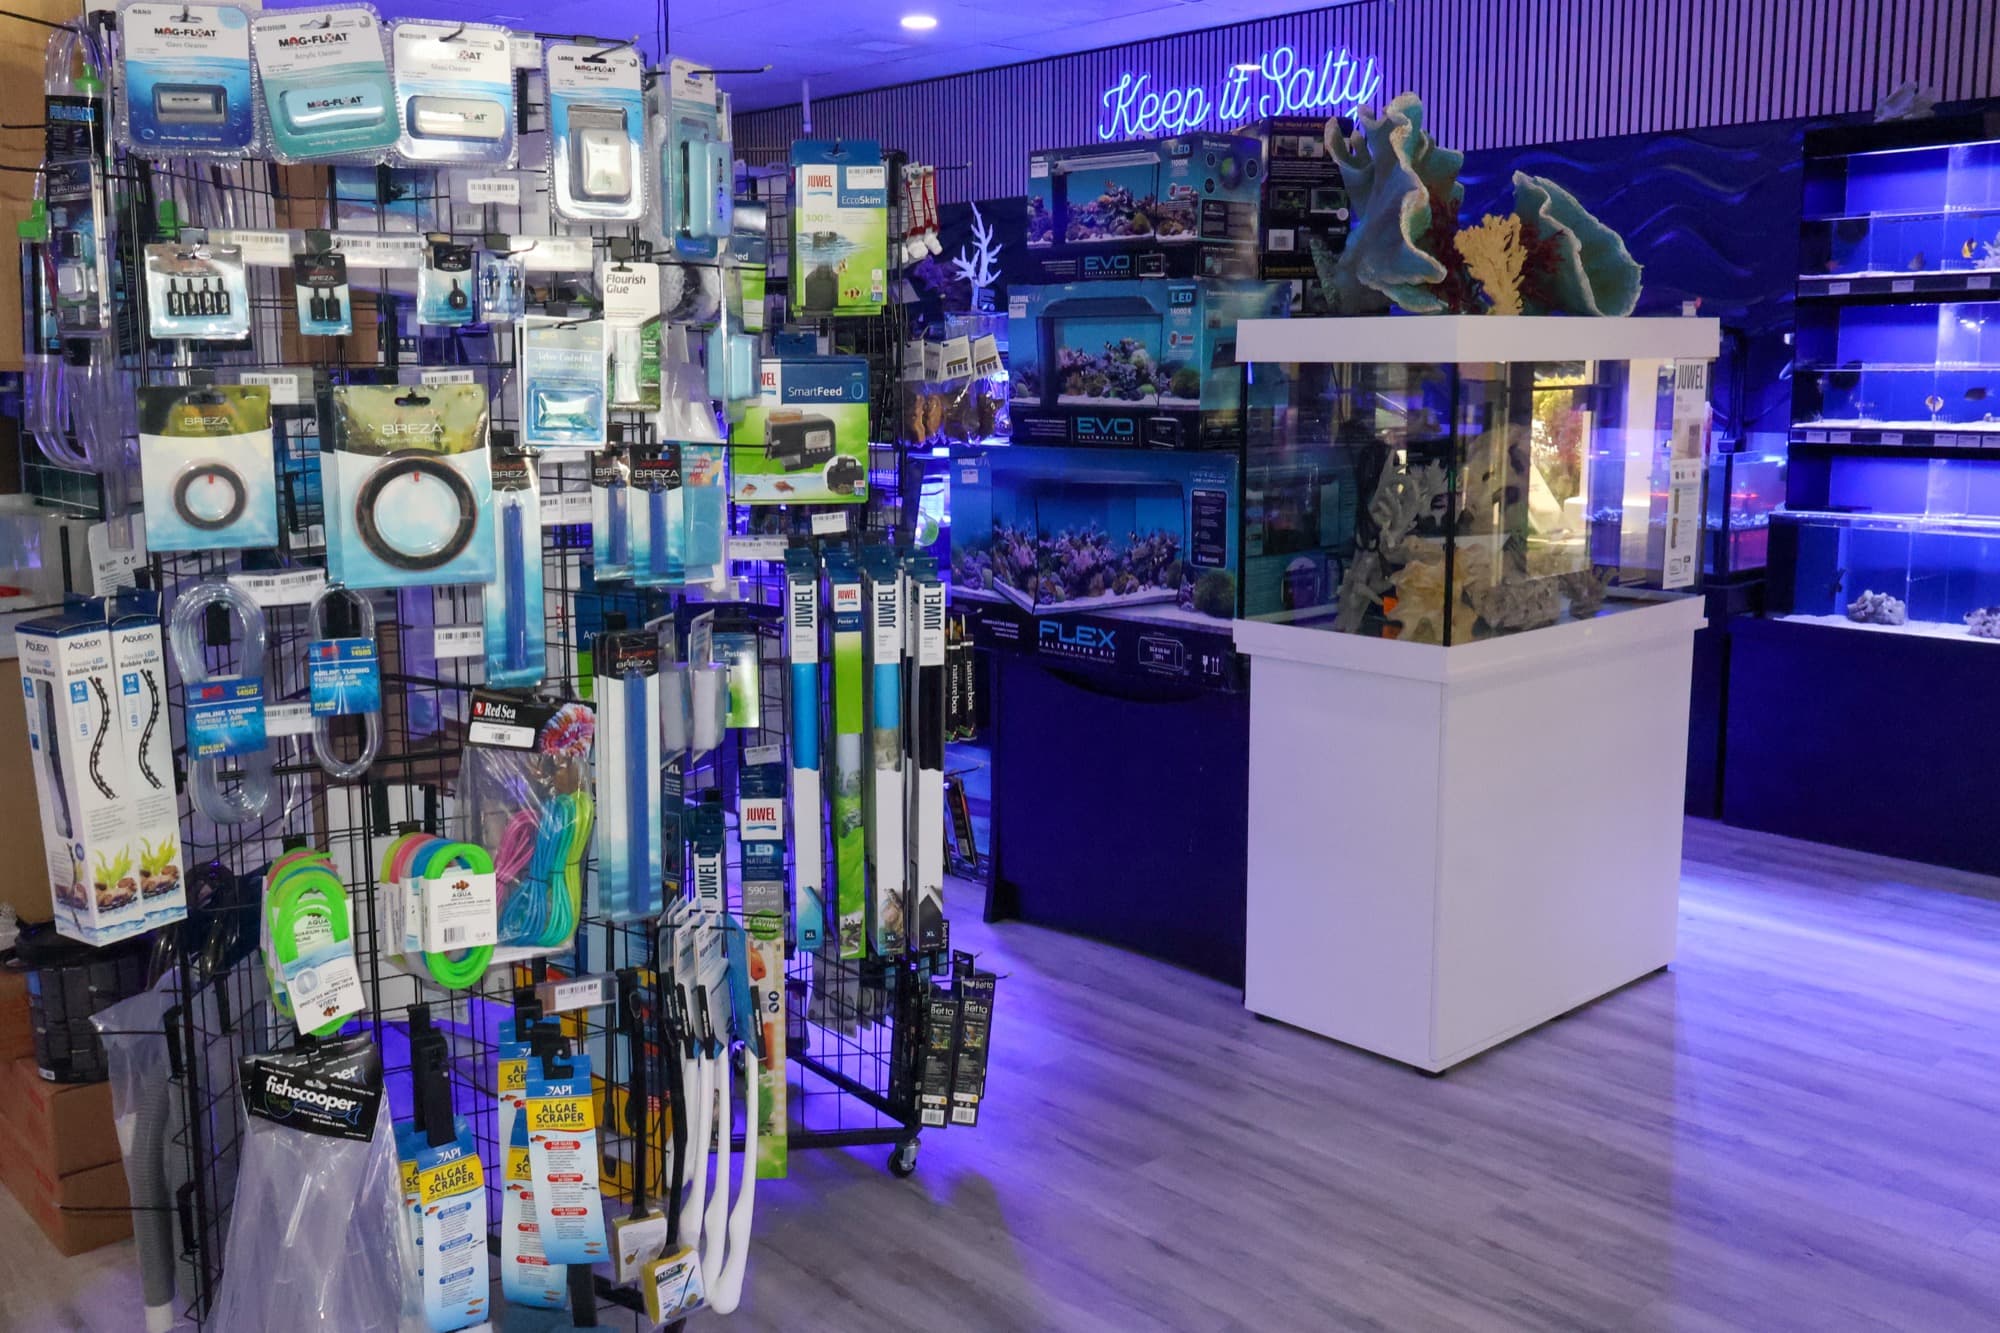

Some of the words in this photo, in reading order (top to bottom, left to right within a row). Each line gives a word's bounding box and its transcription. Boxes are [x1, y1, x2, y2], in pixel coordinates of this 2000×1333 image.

[154, 27, 216, 38] MAG-FLOAT
[278, 33, 348, 47] MAG-FLOAT
[1099, 74, 1211, 140] Keep
[1220, 67, 1250, 119] it
[1260, 47, 1380, 130] Salty
[808, 175, 833, 188] JUWEL
[841, 196, 881, 205] EccoSkim
[1084, 255, 1130, 270] EVO
[606, 273, 647, 286] Flourish
[606, 284, 629, 294] Glue
[1171, 292, 1192, 303] LED
[1677, 365, 1704, 391] JUWEL
[788, 386, 842, 397] SmartFeed
[184, 416, 230, 426] BREZA
[1077, 417, 1134, 434] EVO
[382, 424, 444, 434] BREZA
[491, 470, 530, 478] BREZA
[634, 469, 679, 479] BREZA
[837, 589, 857, 600] JUWEL
[795, 589, 813, 629] JUWEL
[878, 589, 896, 628] JUWEL
[924, 591, 941, 630] JUWEL
[122, 633, 154, 644] Aqueon
[1039, 620, 1116, 650] FLEX
[68, 639, 102, 651] Aqueon
[616, 659, 652, 670] BREZA
[967, 661, 975, 710] naturebox
[484, 702, 501, 717] Red
[501, 704, 516, 719] Sea
[746, 807, 777, 822] JUWEL
[746, 844, 774, 856] LED
[698, 861, 718, 900] JUWEL
[747, 886, 766, 896] 590
[307, 918, 329, 926] AQUA
[930, 1004, 954, 1016] Betta
[964, 1003, 988, 1014] Betta
[266, 1075, 357, 1111] fishscooper
[551, 1085, 572, 1095] API
[541, 1103, 577, 1113] ALGAE
[536, 1112, 584, 1123] SCRAPER
[442, 1147, 462, 1161] API
[433, 1164, 468, 1183] ALGAE
[428, 1172, 474, 1195] SCRAPER
